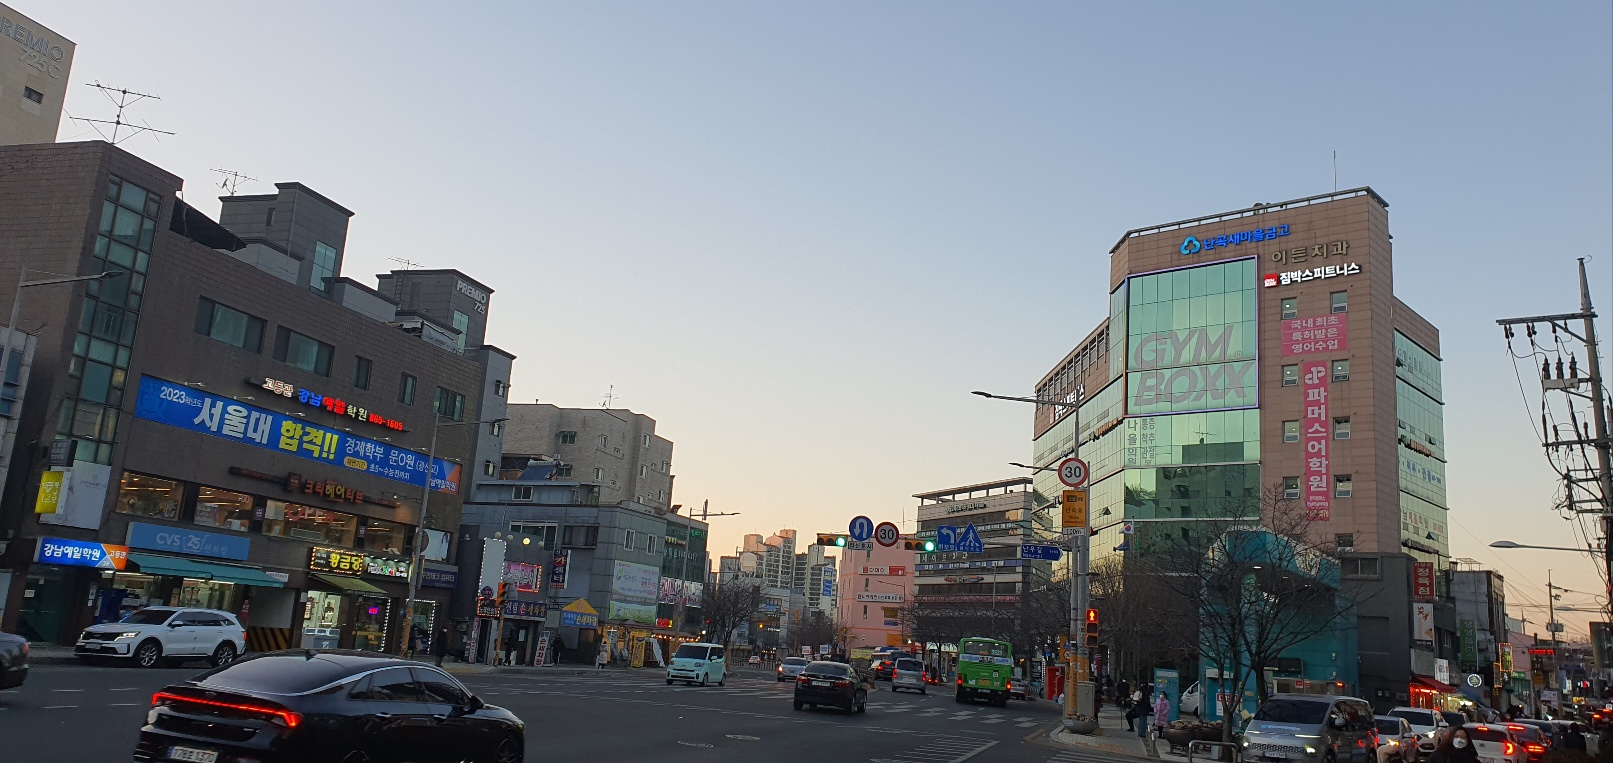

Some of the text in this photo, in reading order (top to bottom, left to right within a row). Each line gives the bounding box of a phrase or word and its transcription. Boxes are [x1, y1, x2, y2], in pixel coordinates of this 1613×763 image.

[1203, 223, 1290, 250] 난곡새마을금고
[1271, 240, 1349, 265] 이든치과
[1279, 262, 1360, 285] 짐박스피트니스
[457, 280, 487, 303] PREMIO
[474, 301, 486, 314] 725
[1291, 316, 1339, 329] 국내 최초
[1134, 325, 1234, 368] GYM
[1292, 339, 1338, 353] 영어수업
[1134, 362, 1254, 406] BOXX
[194, 397, 273, 445] 서울대
[279, 420, 339, 461] 합격!!
[369, 413, 403, 431] 865-1605
[1128, 419, 1138, 465] 나을의원
[1307, 386, 1328, 491] 파머스어학원
[346, 438, 384, 461] 경제학부
[1065, 466, 1082, 478] 30
[304, 479, 364, 504] 크리헤어티브
[429, 478, 457, 491] 남예일학원
[156, 533, 181, 546] CVS
[187, 535, 200, 549] 25
[880, 528, 894, 540] 30
[44, 543, 100, 561] 강남예일학원
[329, 553, 363, 571] 황금당
[1418, 567, 1430, 595] 정육점
[504, 602, 518, 614] 신림
[520, 603, 527, 614] 손
[1417, 606, 1424, 615] SK
